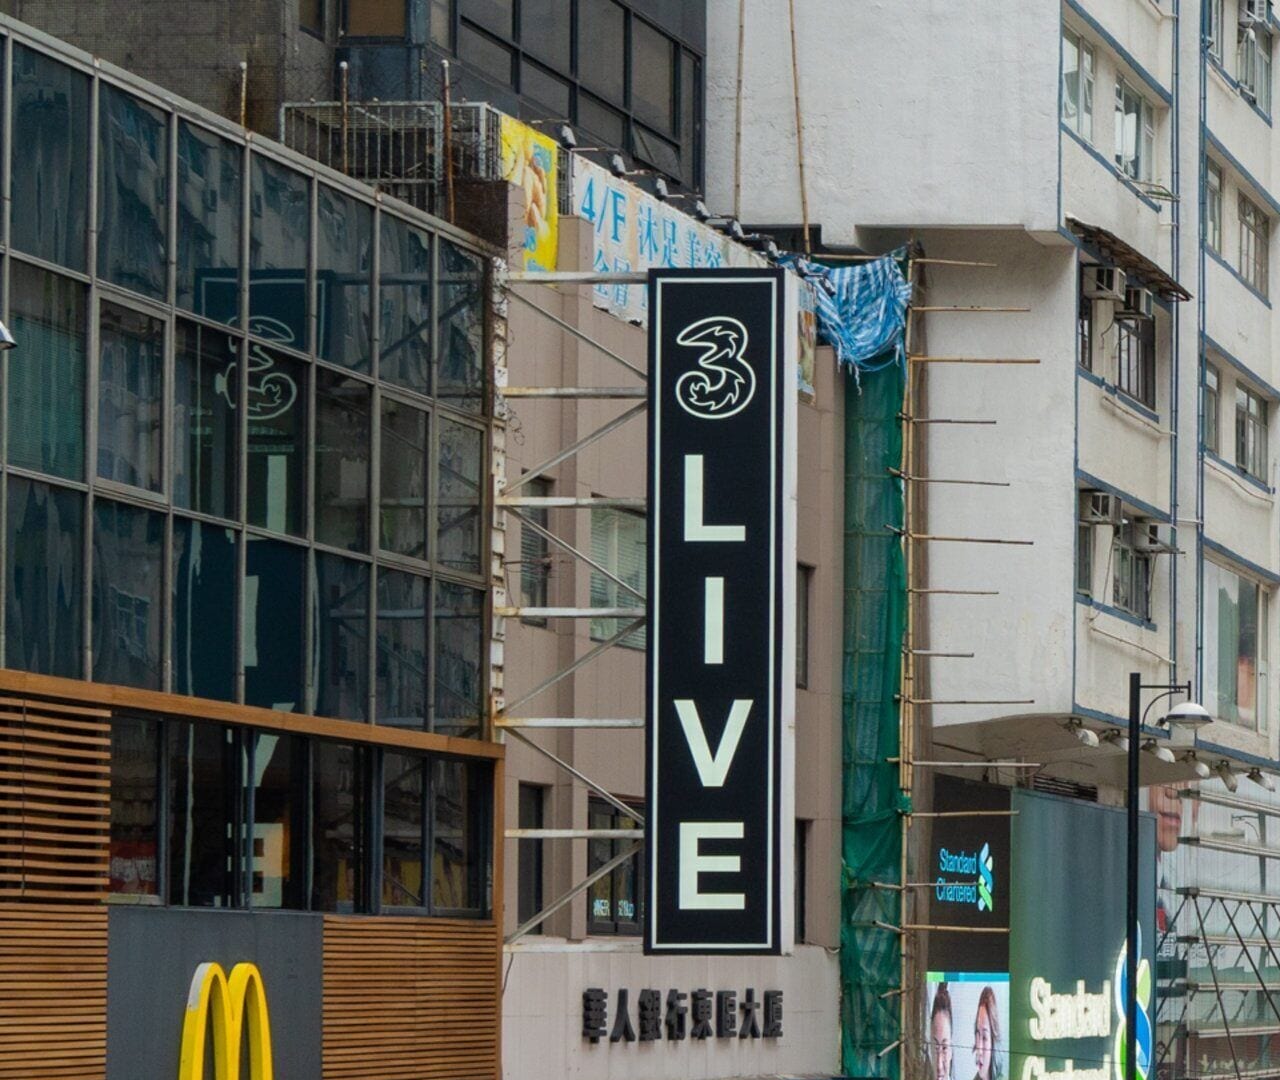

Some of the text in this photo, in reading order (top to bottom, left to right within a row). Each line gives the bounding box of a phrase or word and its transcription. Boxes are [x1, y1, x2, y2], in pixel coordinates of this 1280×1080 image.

[580, 177, 626, 243] 4/F
[673, 454, 755, 910] LIVE
[936, 876, 977, 904] Chartered
[938, 847, 977, 876] Standard
[582, 987, 784, 1044] 華人銀行東區大廈
[1029, 977, 1112, 1042] Standard
